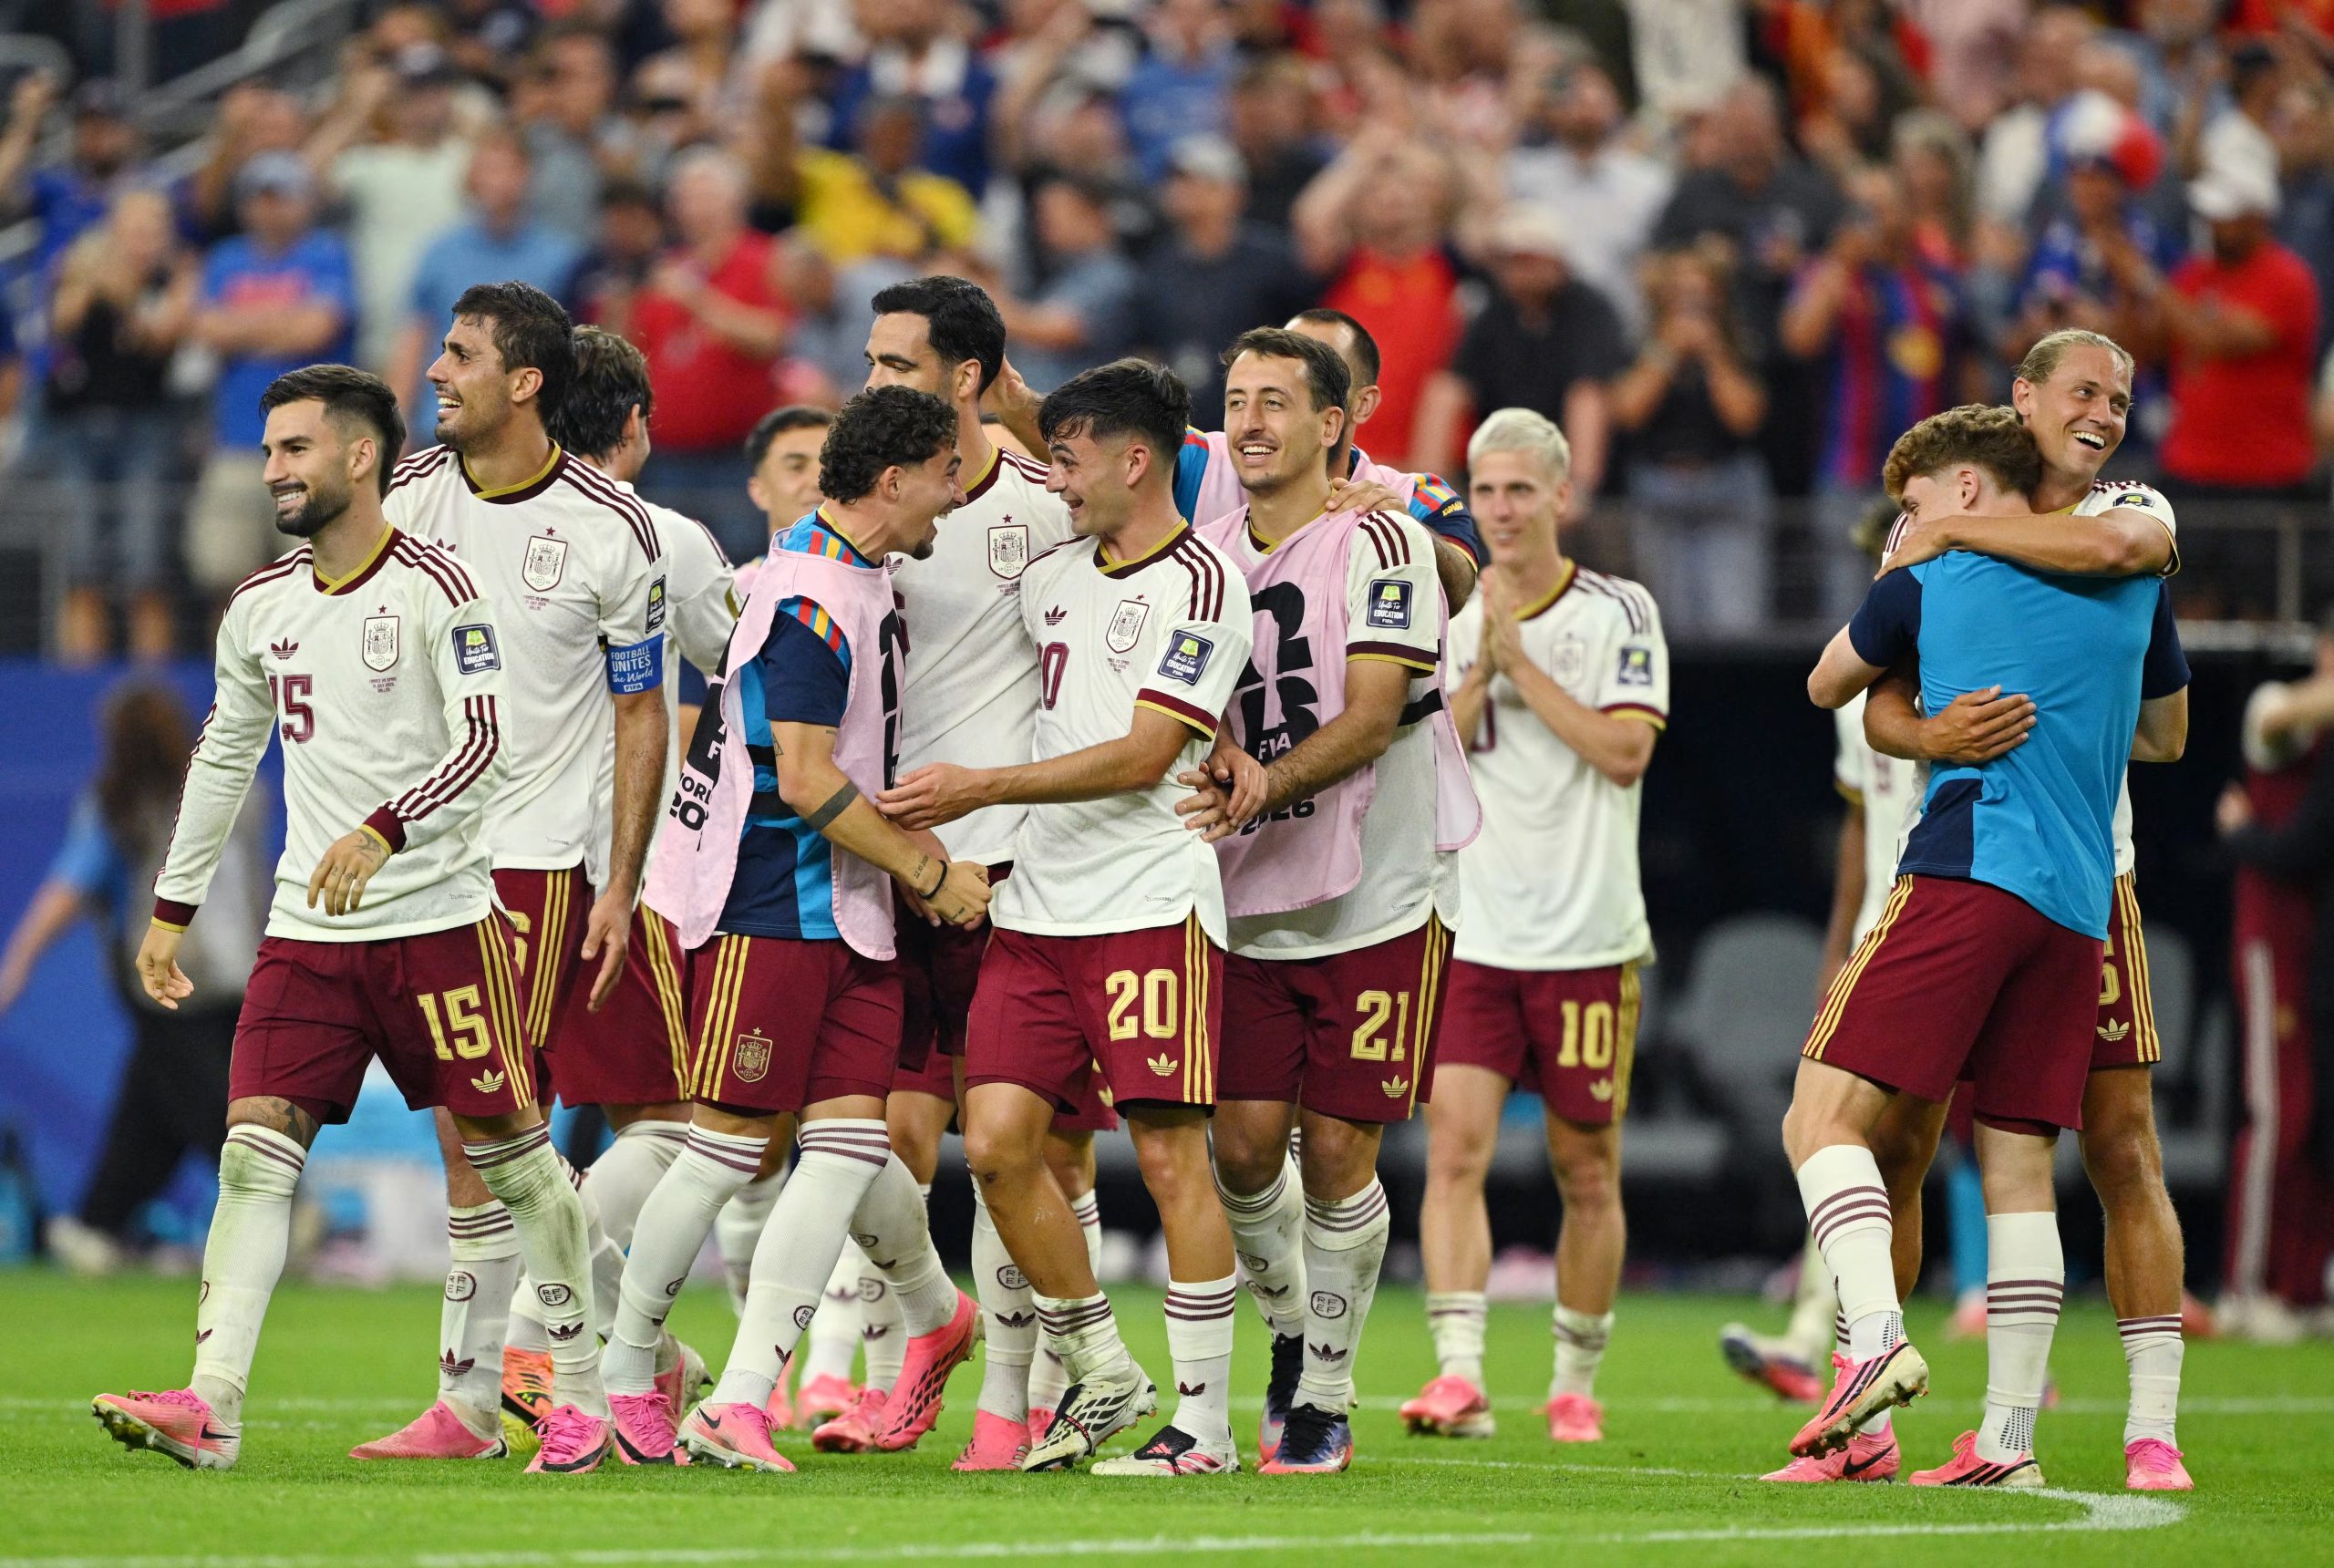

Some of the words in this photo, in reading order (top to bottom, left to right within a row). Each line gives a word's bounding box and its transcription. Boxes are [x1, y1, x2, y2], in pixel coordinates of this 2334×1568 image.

[1373, 609, 1404, 619] EDUCATION
[463, 652, 495, 665] EDUCATION
[611, 645, 650, 660] FOOTBALL
[612, 654, 652, 672] UNITES
[1166, 658, 1197, 675] EDUCATION
[613, 673, 626, 683] the
[626, 666, 654, 683] World
[1036, 642, 1070, 711] 0
[1105, 969, 1178, 1041] 20
[417, 984, 492, 1061] 15
[1350, 990, 1410, 1062] 21
[1557, 1000, 1613, 1068] 10
